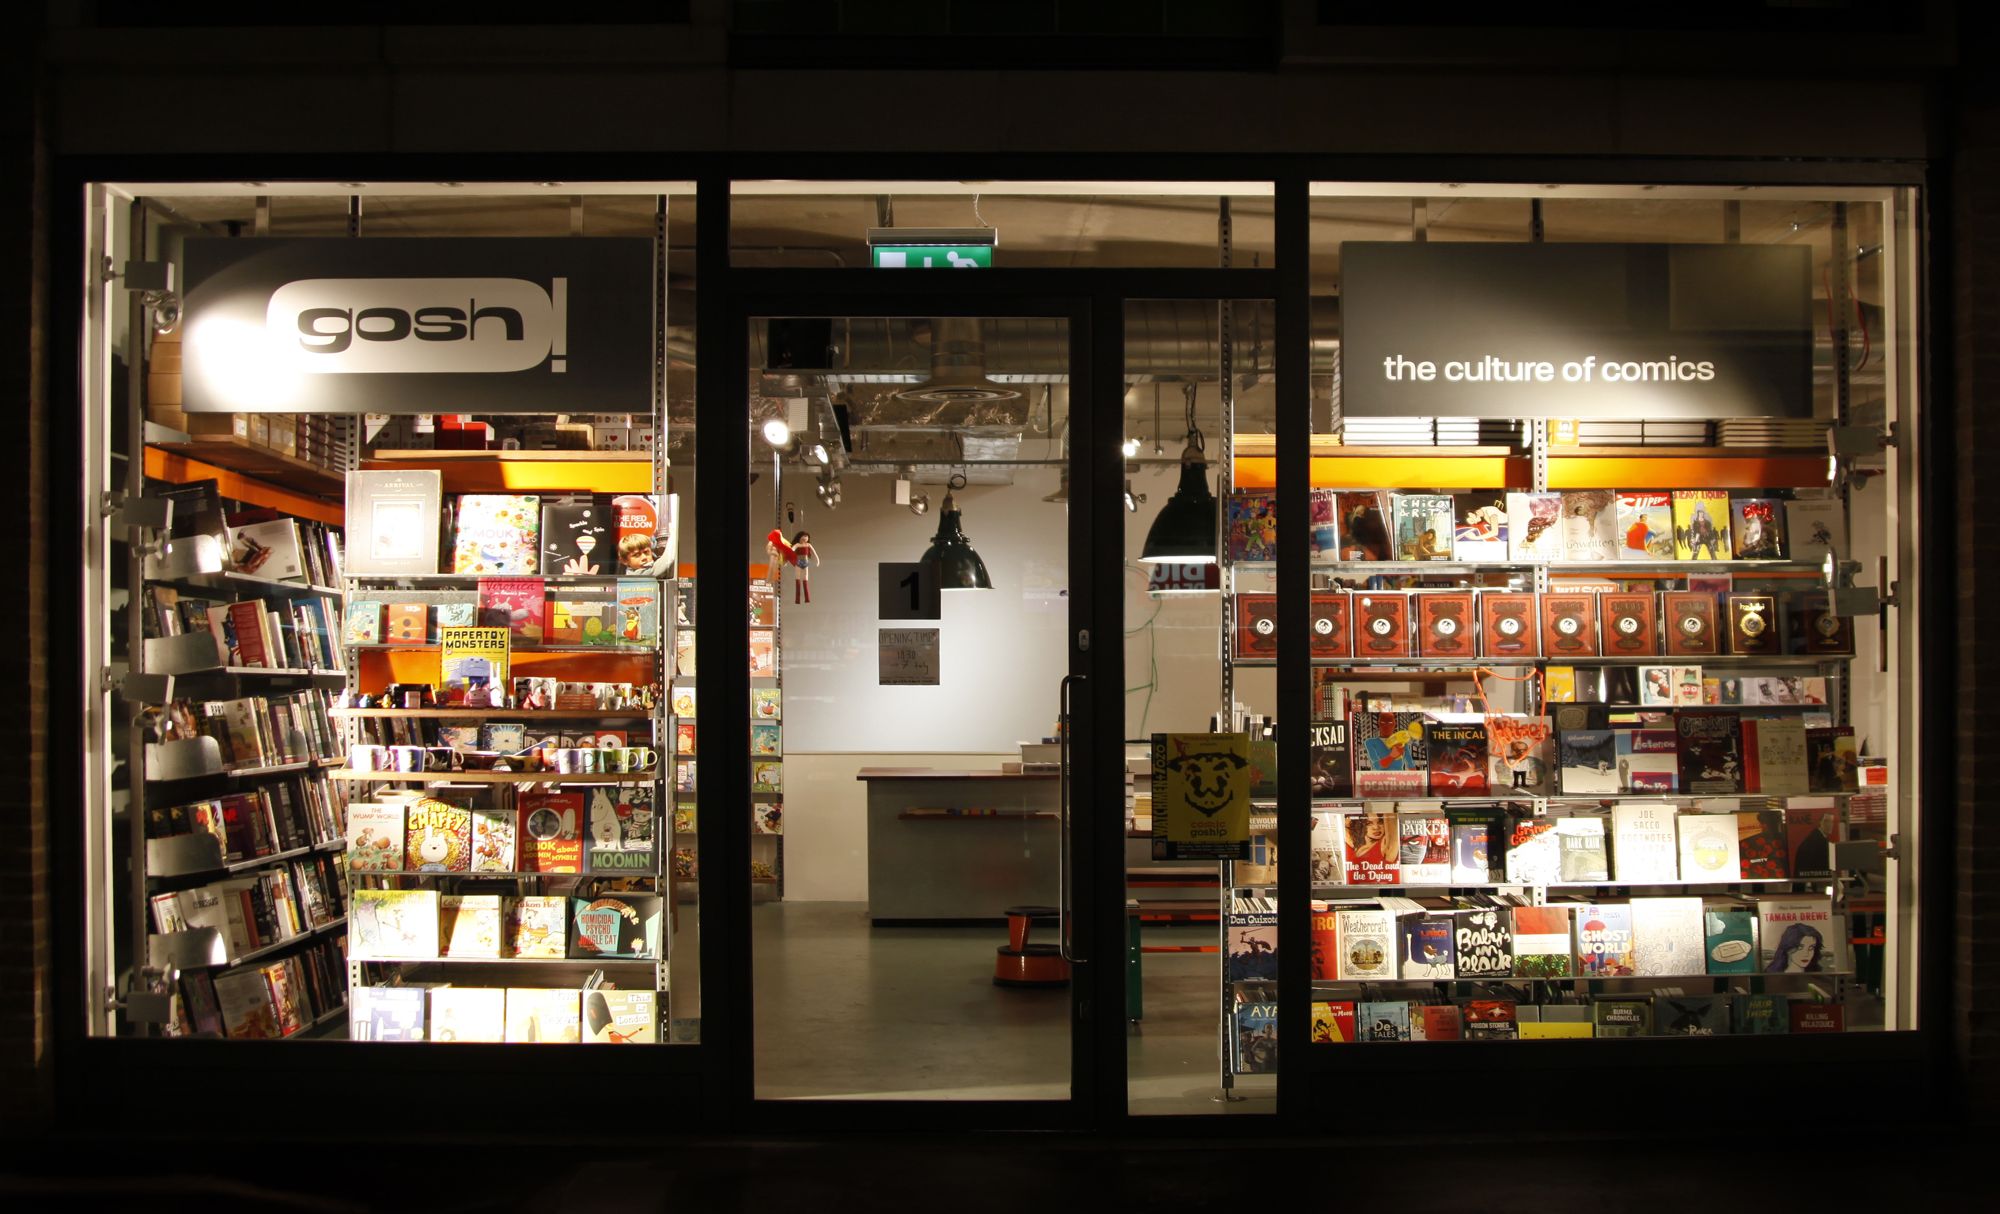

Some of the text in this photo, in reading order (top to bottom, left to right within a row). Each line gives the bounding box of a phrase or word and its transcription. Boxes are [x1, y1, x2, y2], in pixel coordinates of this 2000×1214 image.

[298, 278, 567, 373] gosh!
[1384, 354, 1715, 382] the culture of comics
[446, 631, 505, 639] PAPERTOY
[446, 640, 505, 649] MONSTERS
[1432, 730, 1451, 740] THE
[1638, 810, 1654, 818] JOE
[408, 811, 467, 831] CHAFFY
[1633, 821, 1660, 829] SACCO
[1402, 824, 1448, 835] PARKER
[525, 842, 557, 850] BOOK
[592, 853, 650, 868] MOOMIN
[1346, 861, 1401, 871] The Dead and
[1353, 871, 1393, 882] the Dying
[581, 914, 616, 924] HOMICIDAL
[1230, 915, 1246, 925] Don
[1765, 912, 1828, 921] TAMARA DREWE
[586, 924, 611, 935] PSYCHO
[604, 934, 617, 945] CAT
[1580, 930, 1630, 942] GHOST
[1580, 942, 1631, 954] WORLD
